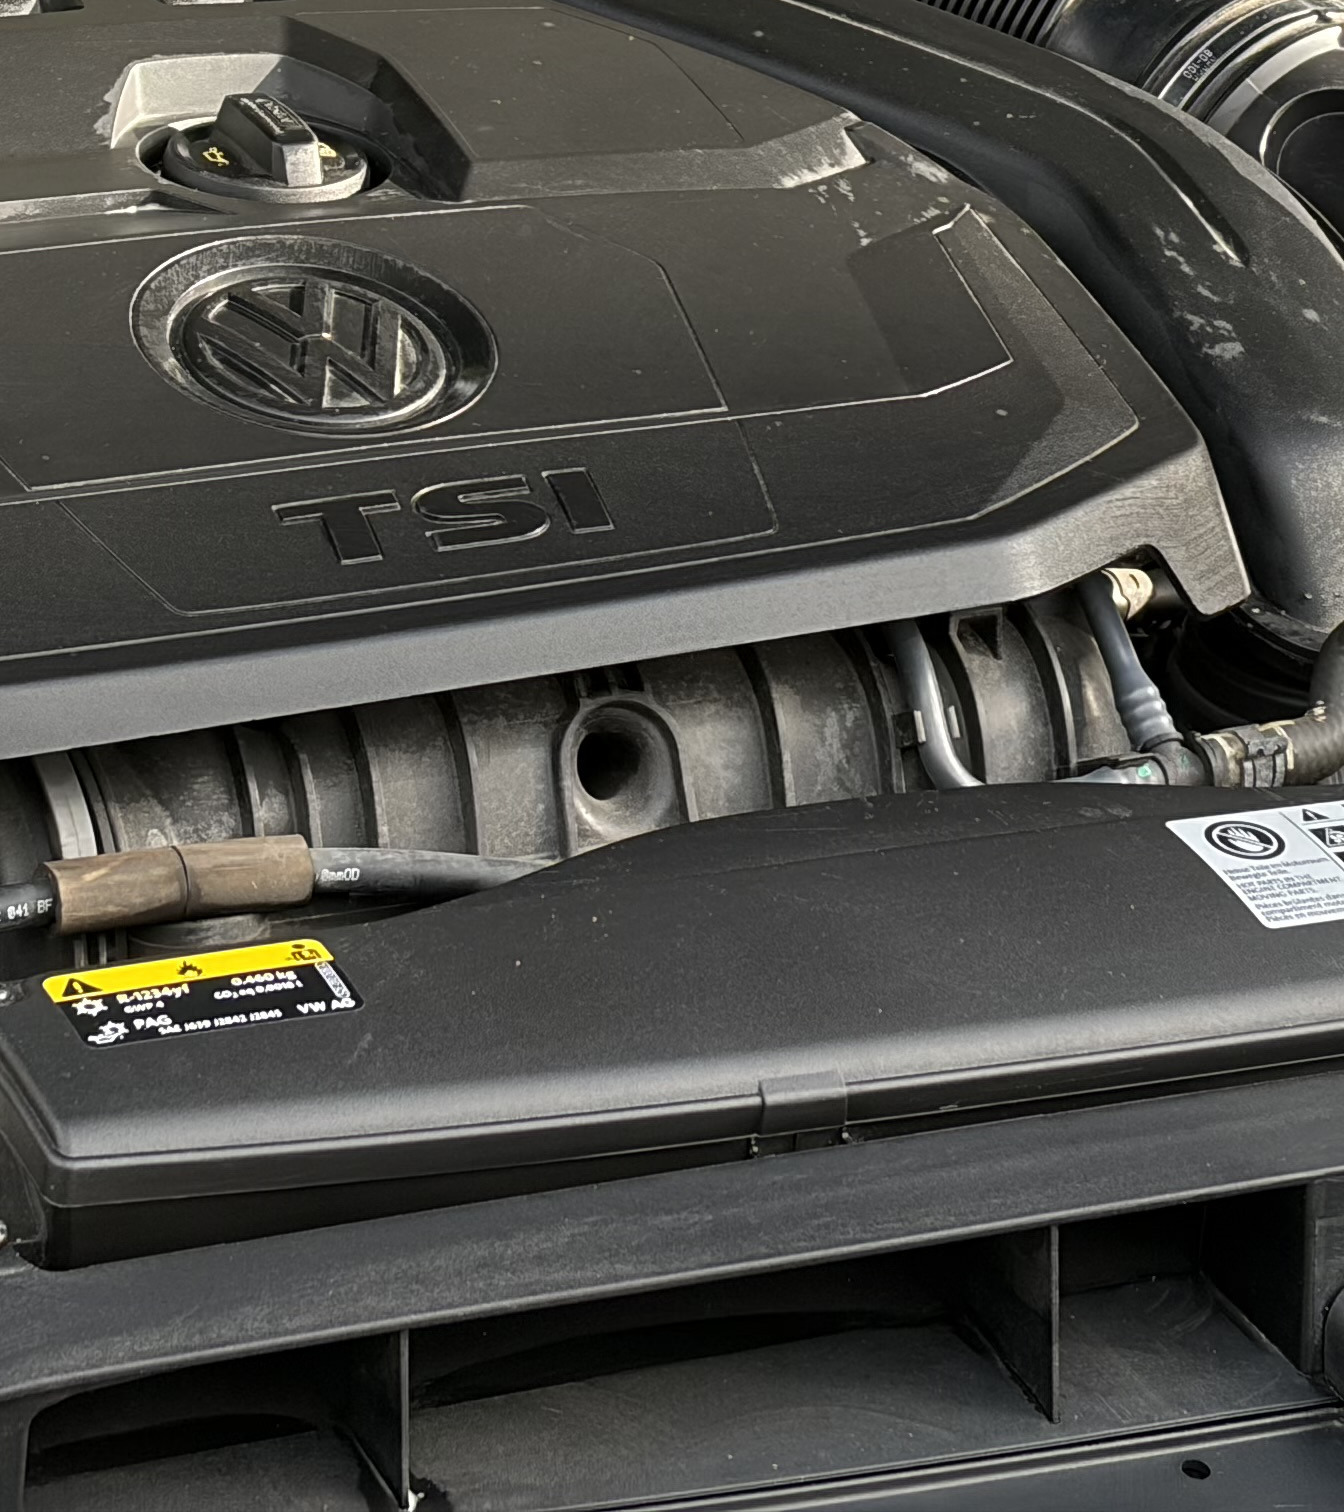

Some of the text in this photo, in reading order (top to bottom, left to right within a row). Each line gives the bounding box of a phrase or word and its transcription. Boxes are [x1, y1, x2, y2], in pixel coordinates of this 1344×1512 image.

[167, 263, 447, 426] VW
[271, 467, 615, 565] TSI
[7, 902, 30, 921] 041
[37, 898, 54, 914] BF
[116, 983, 190, 1005] R-1234yf
[275, 970, 298, 983] kg
[123, 1002, 153, 1014] GWP
[296, 1000, 327, 1015] VW
[330, 996, 356, 1010] AG
[133, 1013, 173, 1031] PAG
